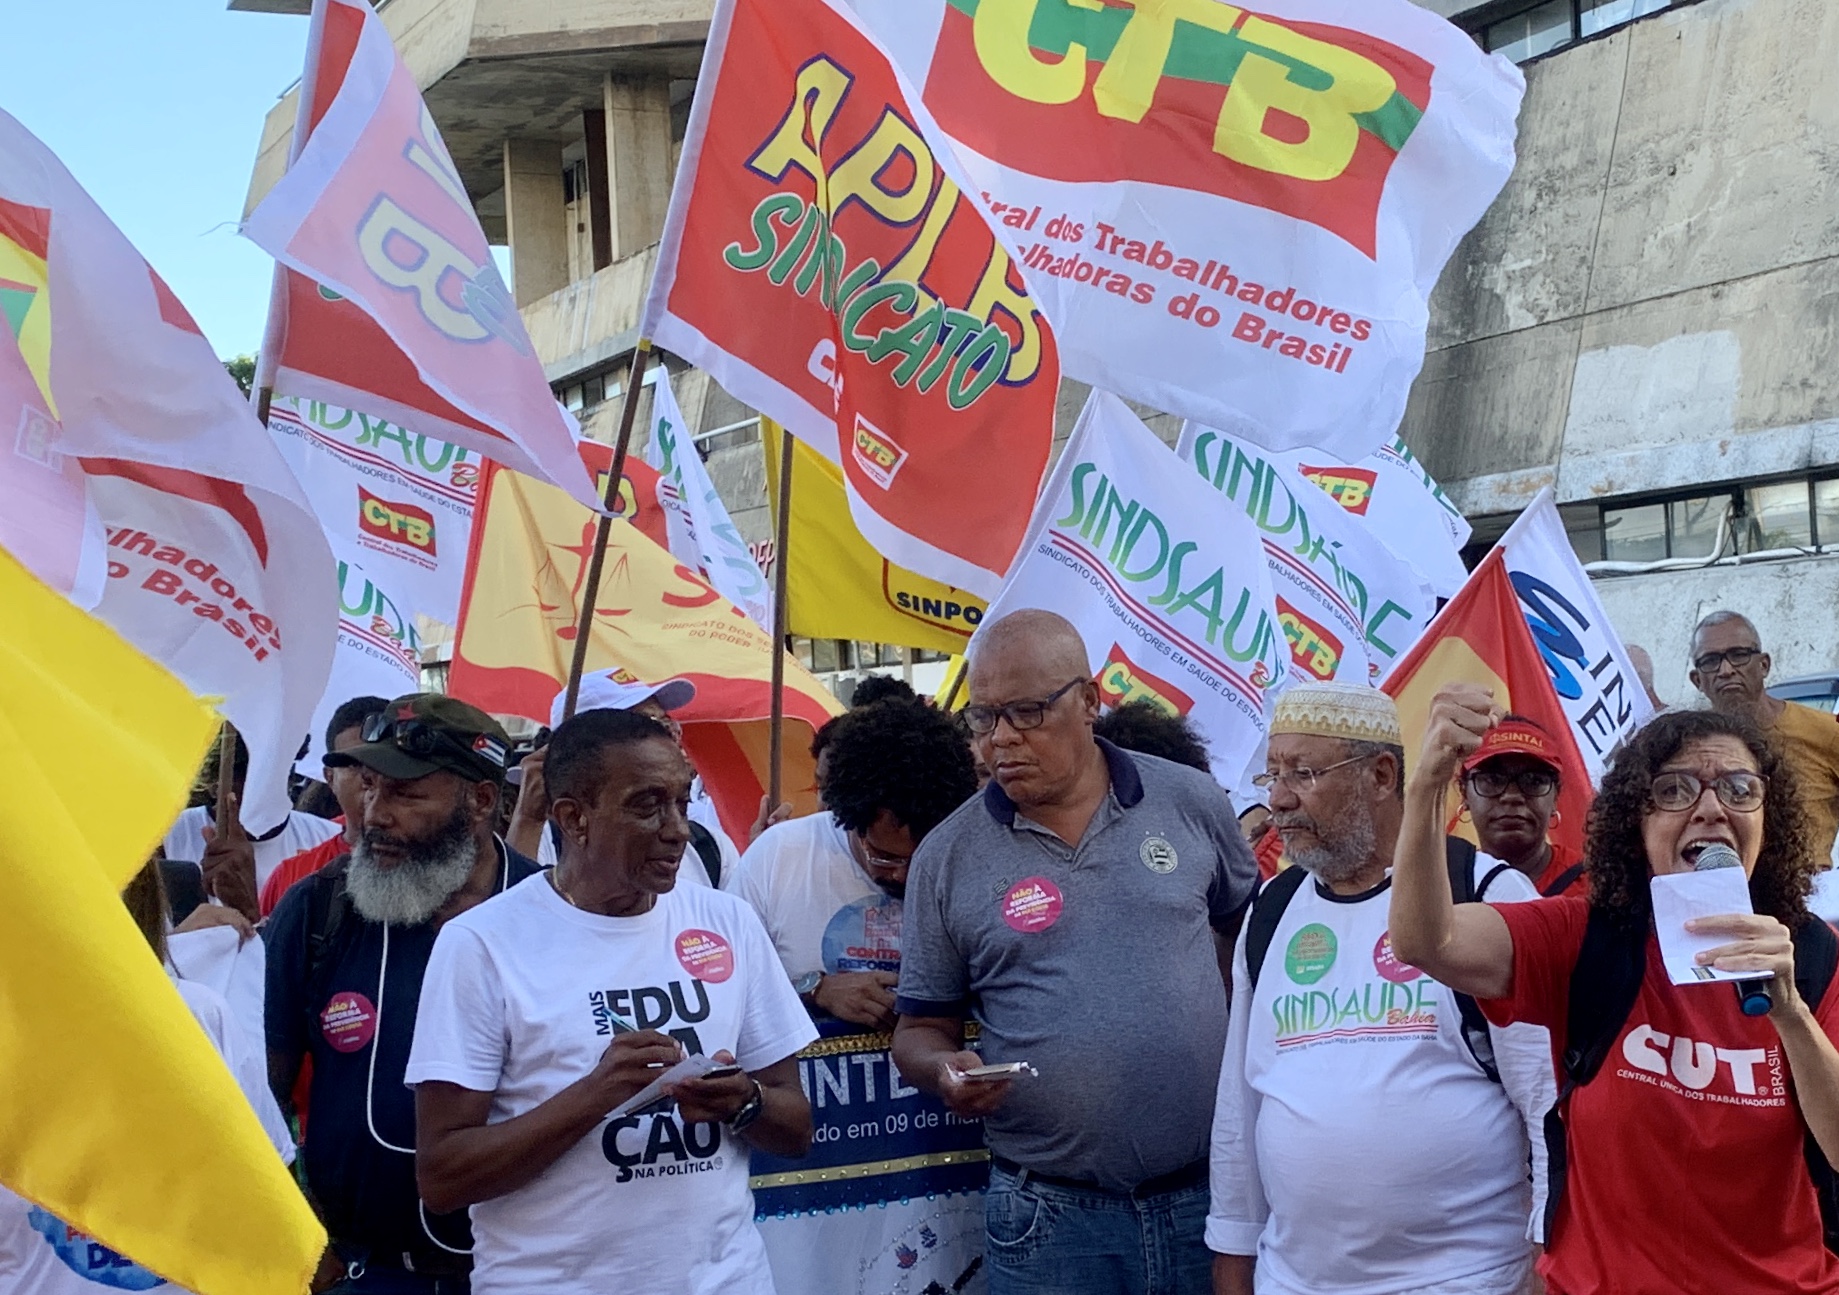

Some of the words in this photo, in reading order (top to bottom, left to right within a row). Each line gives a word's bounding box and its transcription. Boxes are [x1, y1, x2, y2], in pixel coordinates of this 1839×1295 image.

[970, 0, 1397, 182] CTB
[1044, 213, 1085, 243] dos
[1094, 221, 1372, 342] Trabalhadores
[1017, 243, 1156, 304] lhadoras
[1167, 293, 1221, 328] do
[1231, 311, 1353, 374] Brasil
[858, 429, 896, 466] CTB
[364, 499, 431, 546] CTB
[452, 503, 473, 518] ESTA
[106, 528, 281, 650] lhadores
[1057, 462, 1284, 687] SINDSAUD
[1268, 559, 1322, 602] BALHADORES
[141, 569, 268, 661] Brasil
[896, 592, 983, 625] SINPO
[1038, 544, 1090, 580] SINDICATO
[1104, 591, 1171, 656] TRABALHADORES
[1171, 651, 1188, 667] EM
[1187, 661, 1220, 691] SAÚDE
[1221, 686, 1237, 702] DO
[347, 638, 363, 651] DO
[365, 646, 403, 673] ESTADO
[1278, 612, 1337, 676] CTB
[838, 958, 900, 971] REFORM
[847, 946, 900, 959] CONTR
[589, 991, 610, 1035] MAIS
[605, 979, 711, 1036] EDU
[1386, 1008, 1436, 1025] Bahia
[1623, 1024, 1766, 1095] CUT
[1768, 1045, 1785, 1095] BRASIL
[1617, 1069, 1657, 1085] CENTRAL
[1685, 1092, 1704, 1101] DOS
[1706, 1094, 1785, 1106] TRABALHADORES
[812, 1123, 841, 1143] do
[847, 1121, 879, 1139] em
[885, 1113, 909, 1134] 09
[914, 1109, 939, 1128] de
[635, 1167, 655, 1179] NA
[659, 1160, 714, 1177] POLÍTICA
